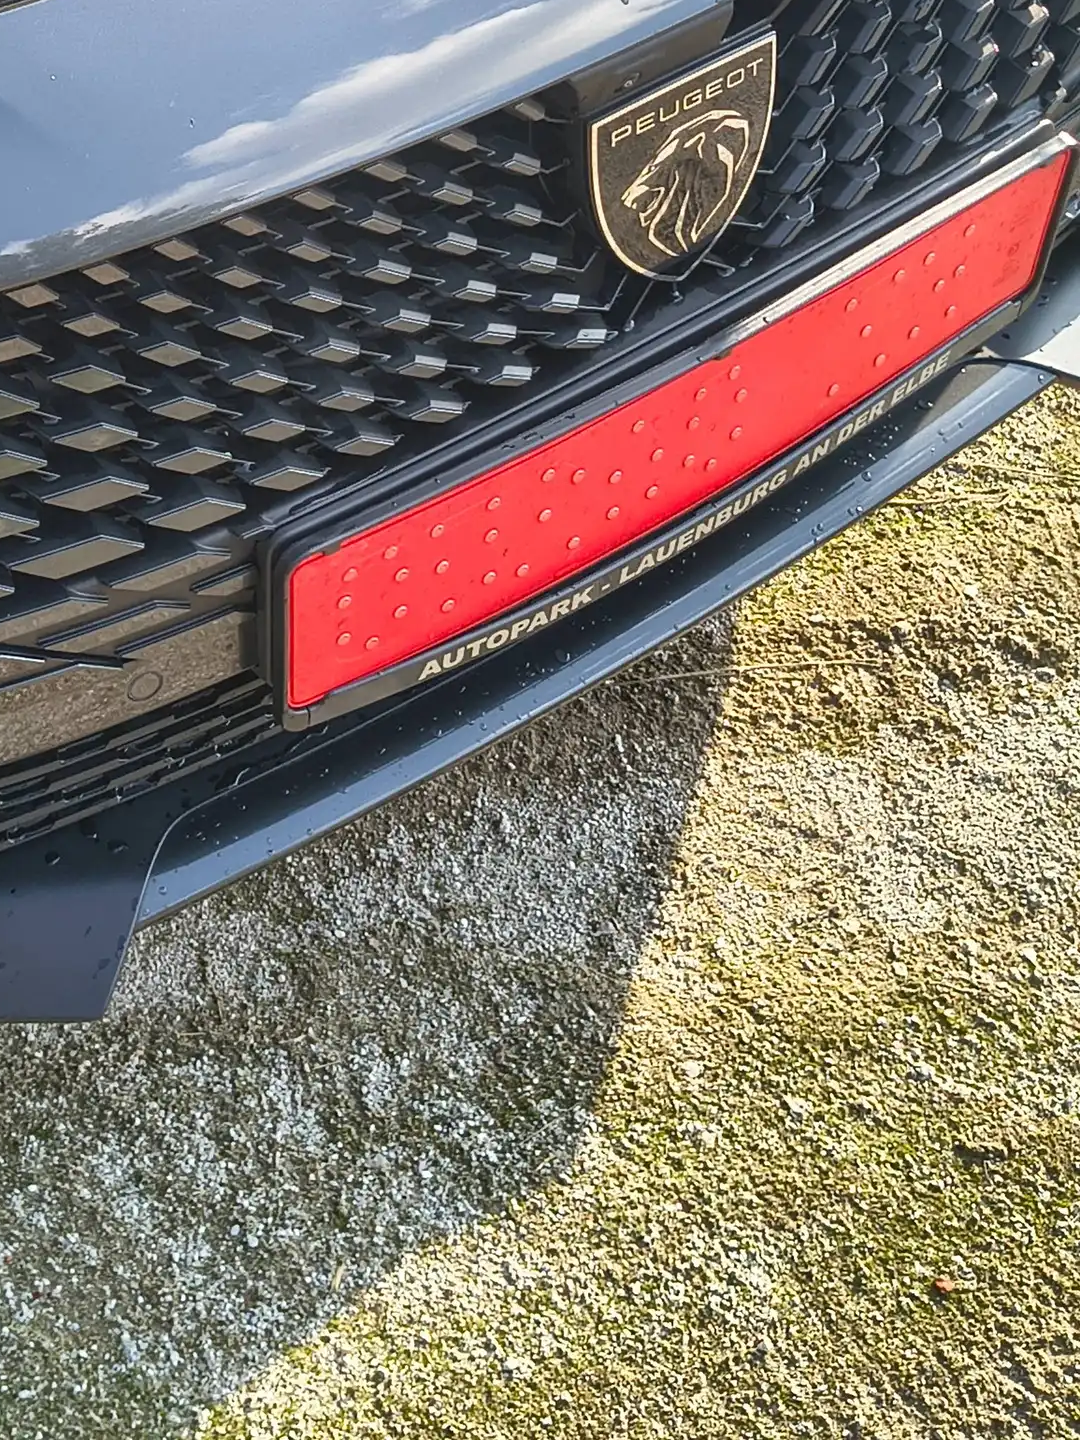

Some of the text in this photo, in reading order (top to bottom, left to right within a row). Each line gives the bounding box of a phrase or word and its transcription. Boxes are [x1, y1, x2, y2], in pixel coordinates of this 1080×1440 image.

[610, 57, 763, 148] PEUGEOT
[418, 589, 595, 681] AUTOPARK
[618, 470, 788, 582] LAUENBURG
[793, 438, 832, 478] AN
[836, 399, 887, 442] DER
[891, 350, 952, 408] ELBE
